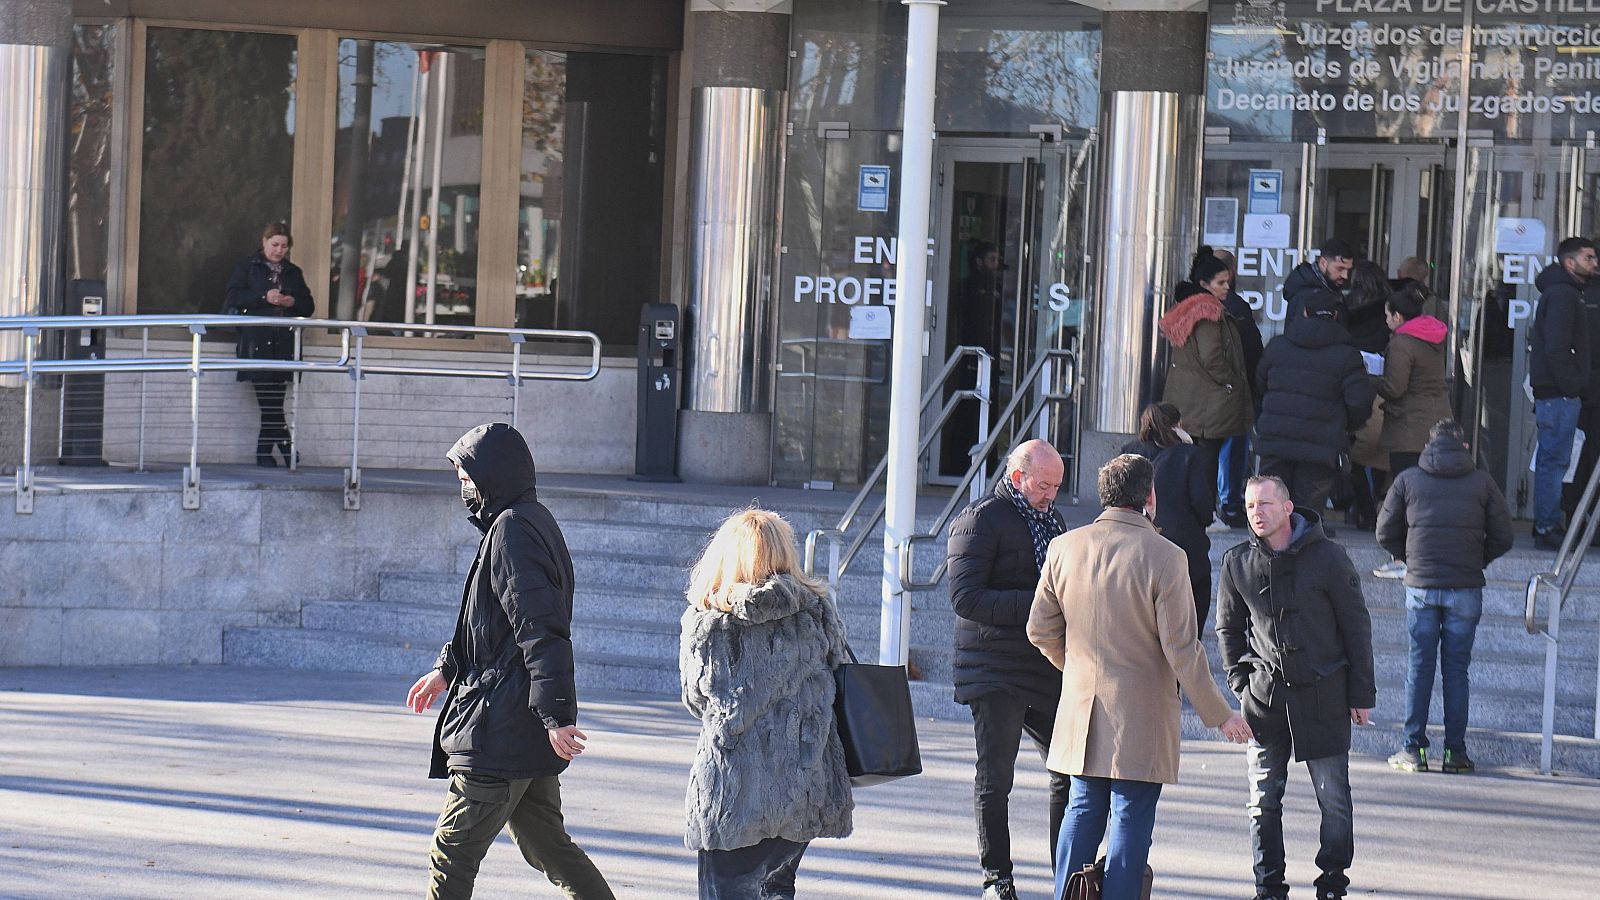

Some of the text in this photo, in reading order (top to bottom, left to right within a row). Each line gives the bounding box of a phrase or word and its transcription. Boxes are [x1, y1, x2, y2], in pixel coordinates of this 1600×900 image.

[1296, 22, 1422, 51] Juzgados
[1429, 22, 1463, 46] de
[1218, 56, 1342, 83] Juzgados
[1350, 56, 1381, 80] de
[1389, 56, 1525, 84] Vigilancia
[1217, 88, 1337, 112] Decanato
[1342, 88, 1375, 112] de
[1382, 89, 1422, 113] los
[1429, 91, 1566, 119] Juzgados
